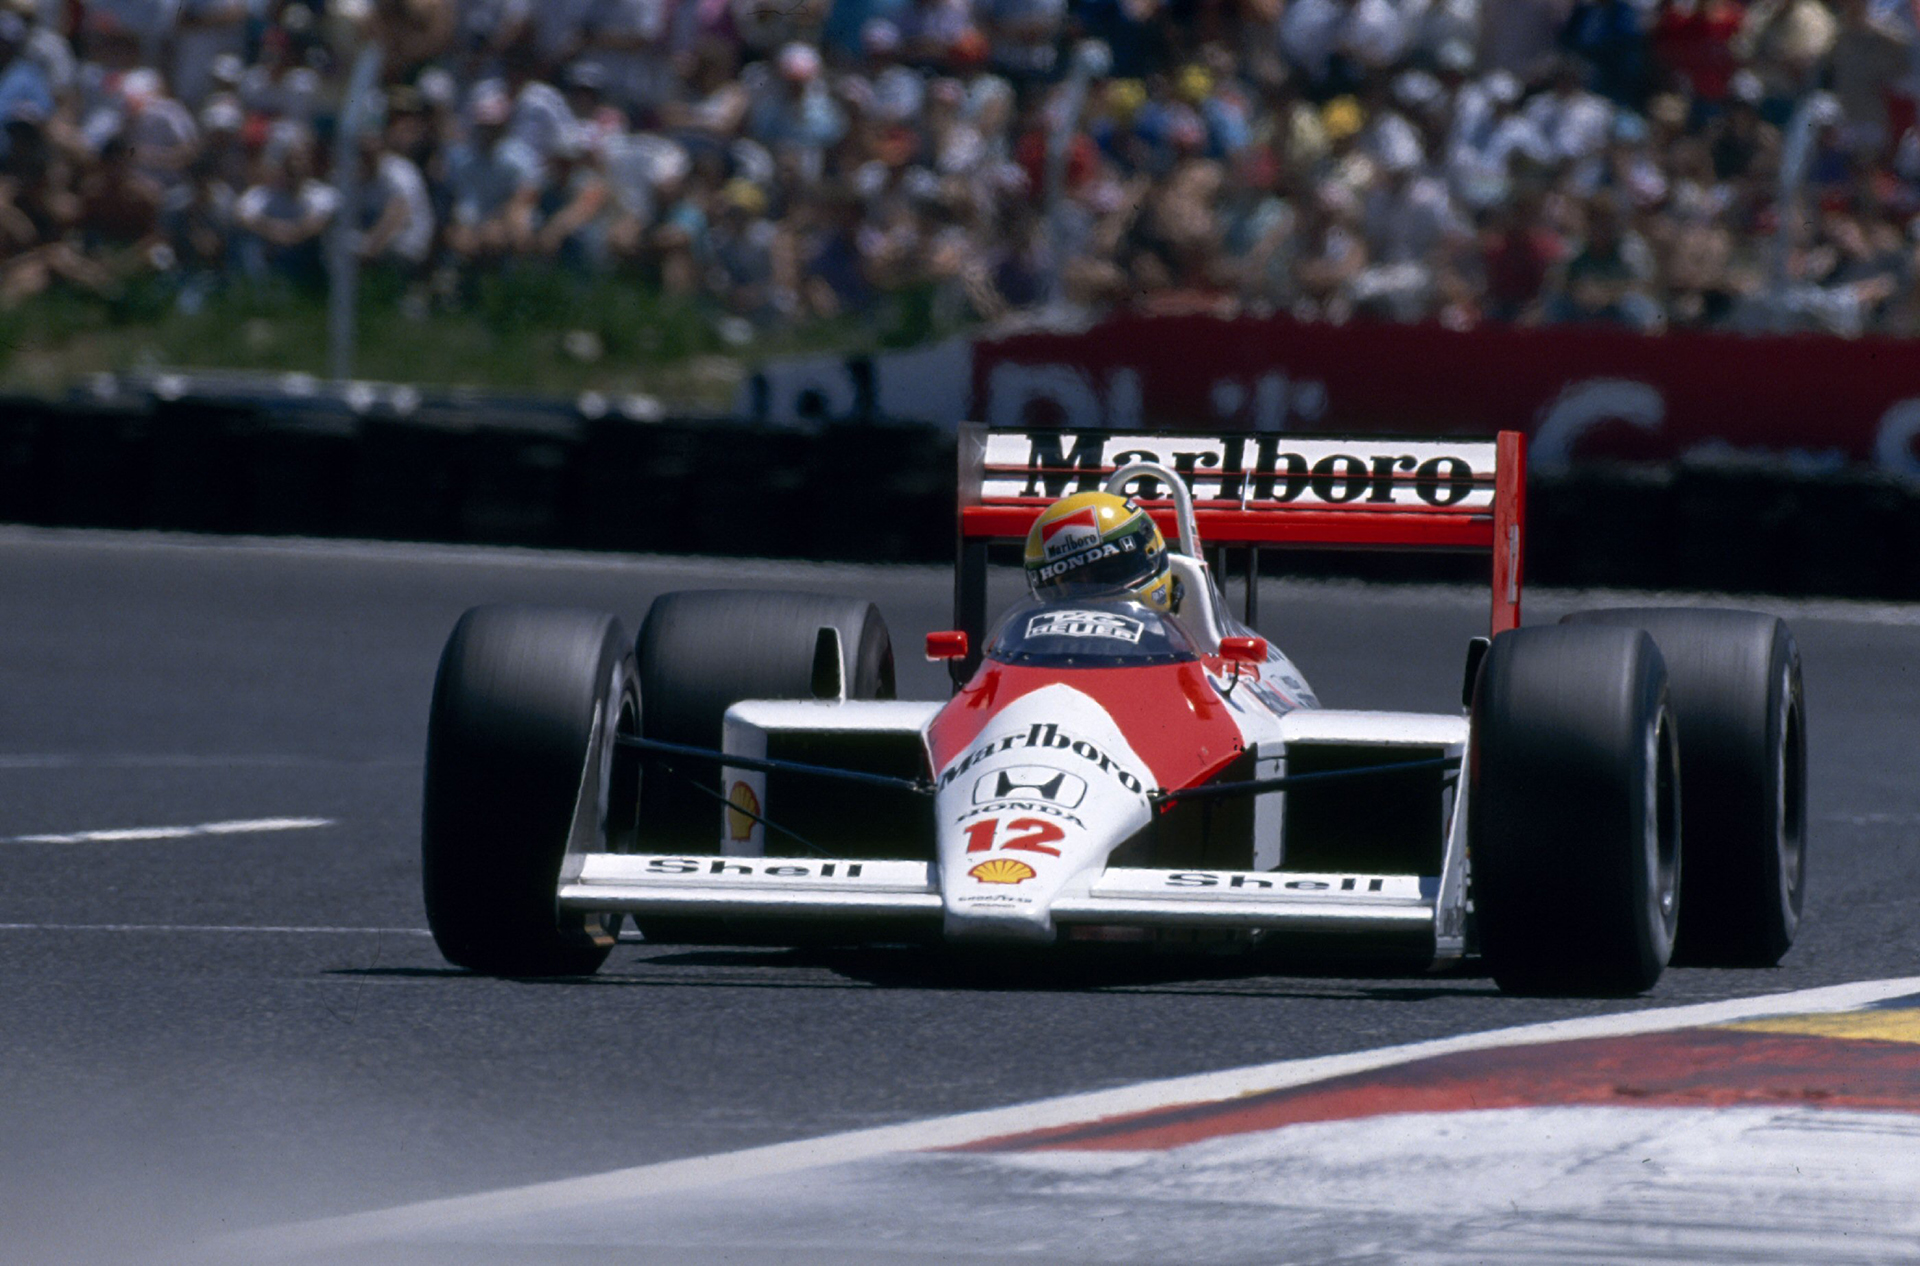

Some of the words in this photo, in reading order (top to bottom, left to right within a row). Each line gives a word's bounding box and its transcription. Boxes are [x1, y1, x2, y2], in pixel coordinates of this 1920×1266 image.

[1019, 434, 1475, 506] Marlboro
[1047, 534, 1097, 557] Marlboro
[1040, 543, 1119, 581] HONDA
[1045, 611, 1126, 626] TAG
[939, 723, 1142, 794] Marlboro
[953, 802, 1087, 830] HONDA
[963, 816, 1066, 858] 12
[646, 858, 863, 875] Shell
[1165, 873, 1383, 890] Shell
